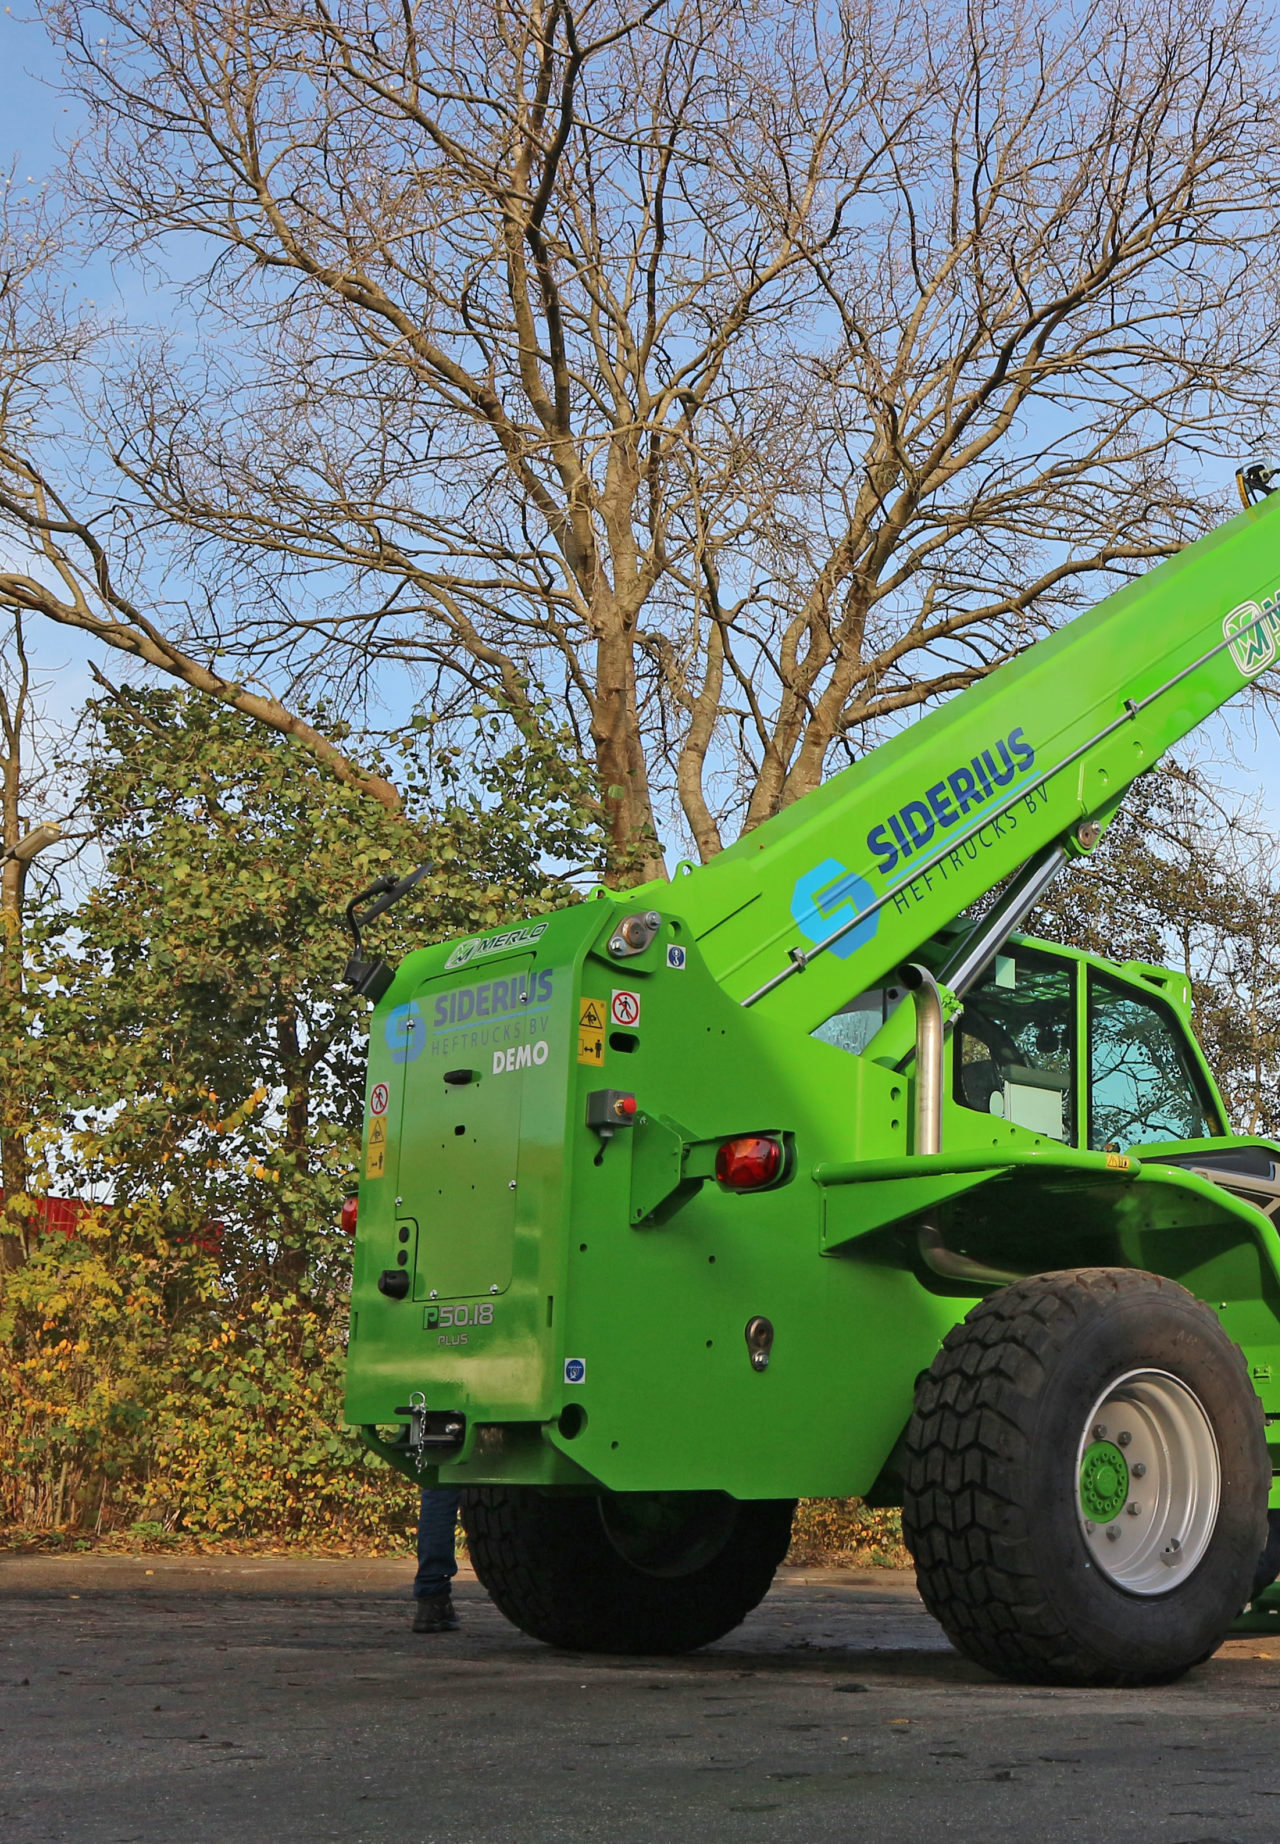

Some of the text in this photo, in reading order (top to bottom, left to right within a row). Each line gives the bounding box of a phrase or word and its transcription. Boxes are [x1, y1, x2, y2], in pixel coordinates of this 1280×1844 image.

[866, 726, 1035, 874] SIDERIUS
[892, 783, 1049, 915] HEFTRUCKS BV
[477, 922, 549, 952] MERLO
[433, 968, 553, 1028] SIDERIUS
[431, 1016, 549, 1056] HEFTRUCKS BV
[492, 1040, 549, 1075] DEMO
[423, 1303, 494, 1330] P50.18
[437, 1333, 469, 1347] PLUS
